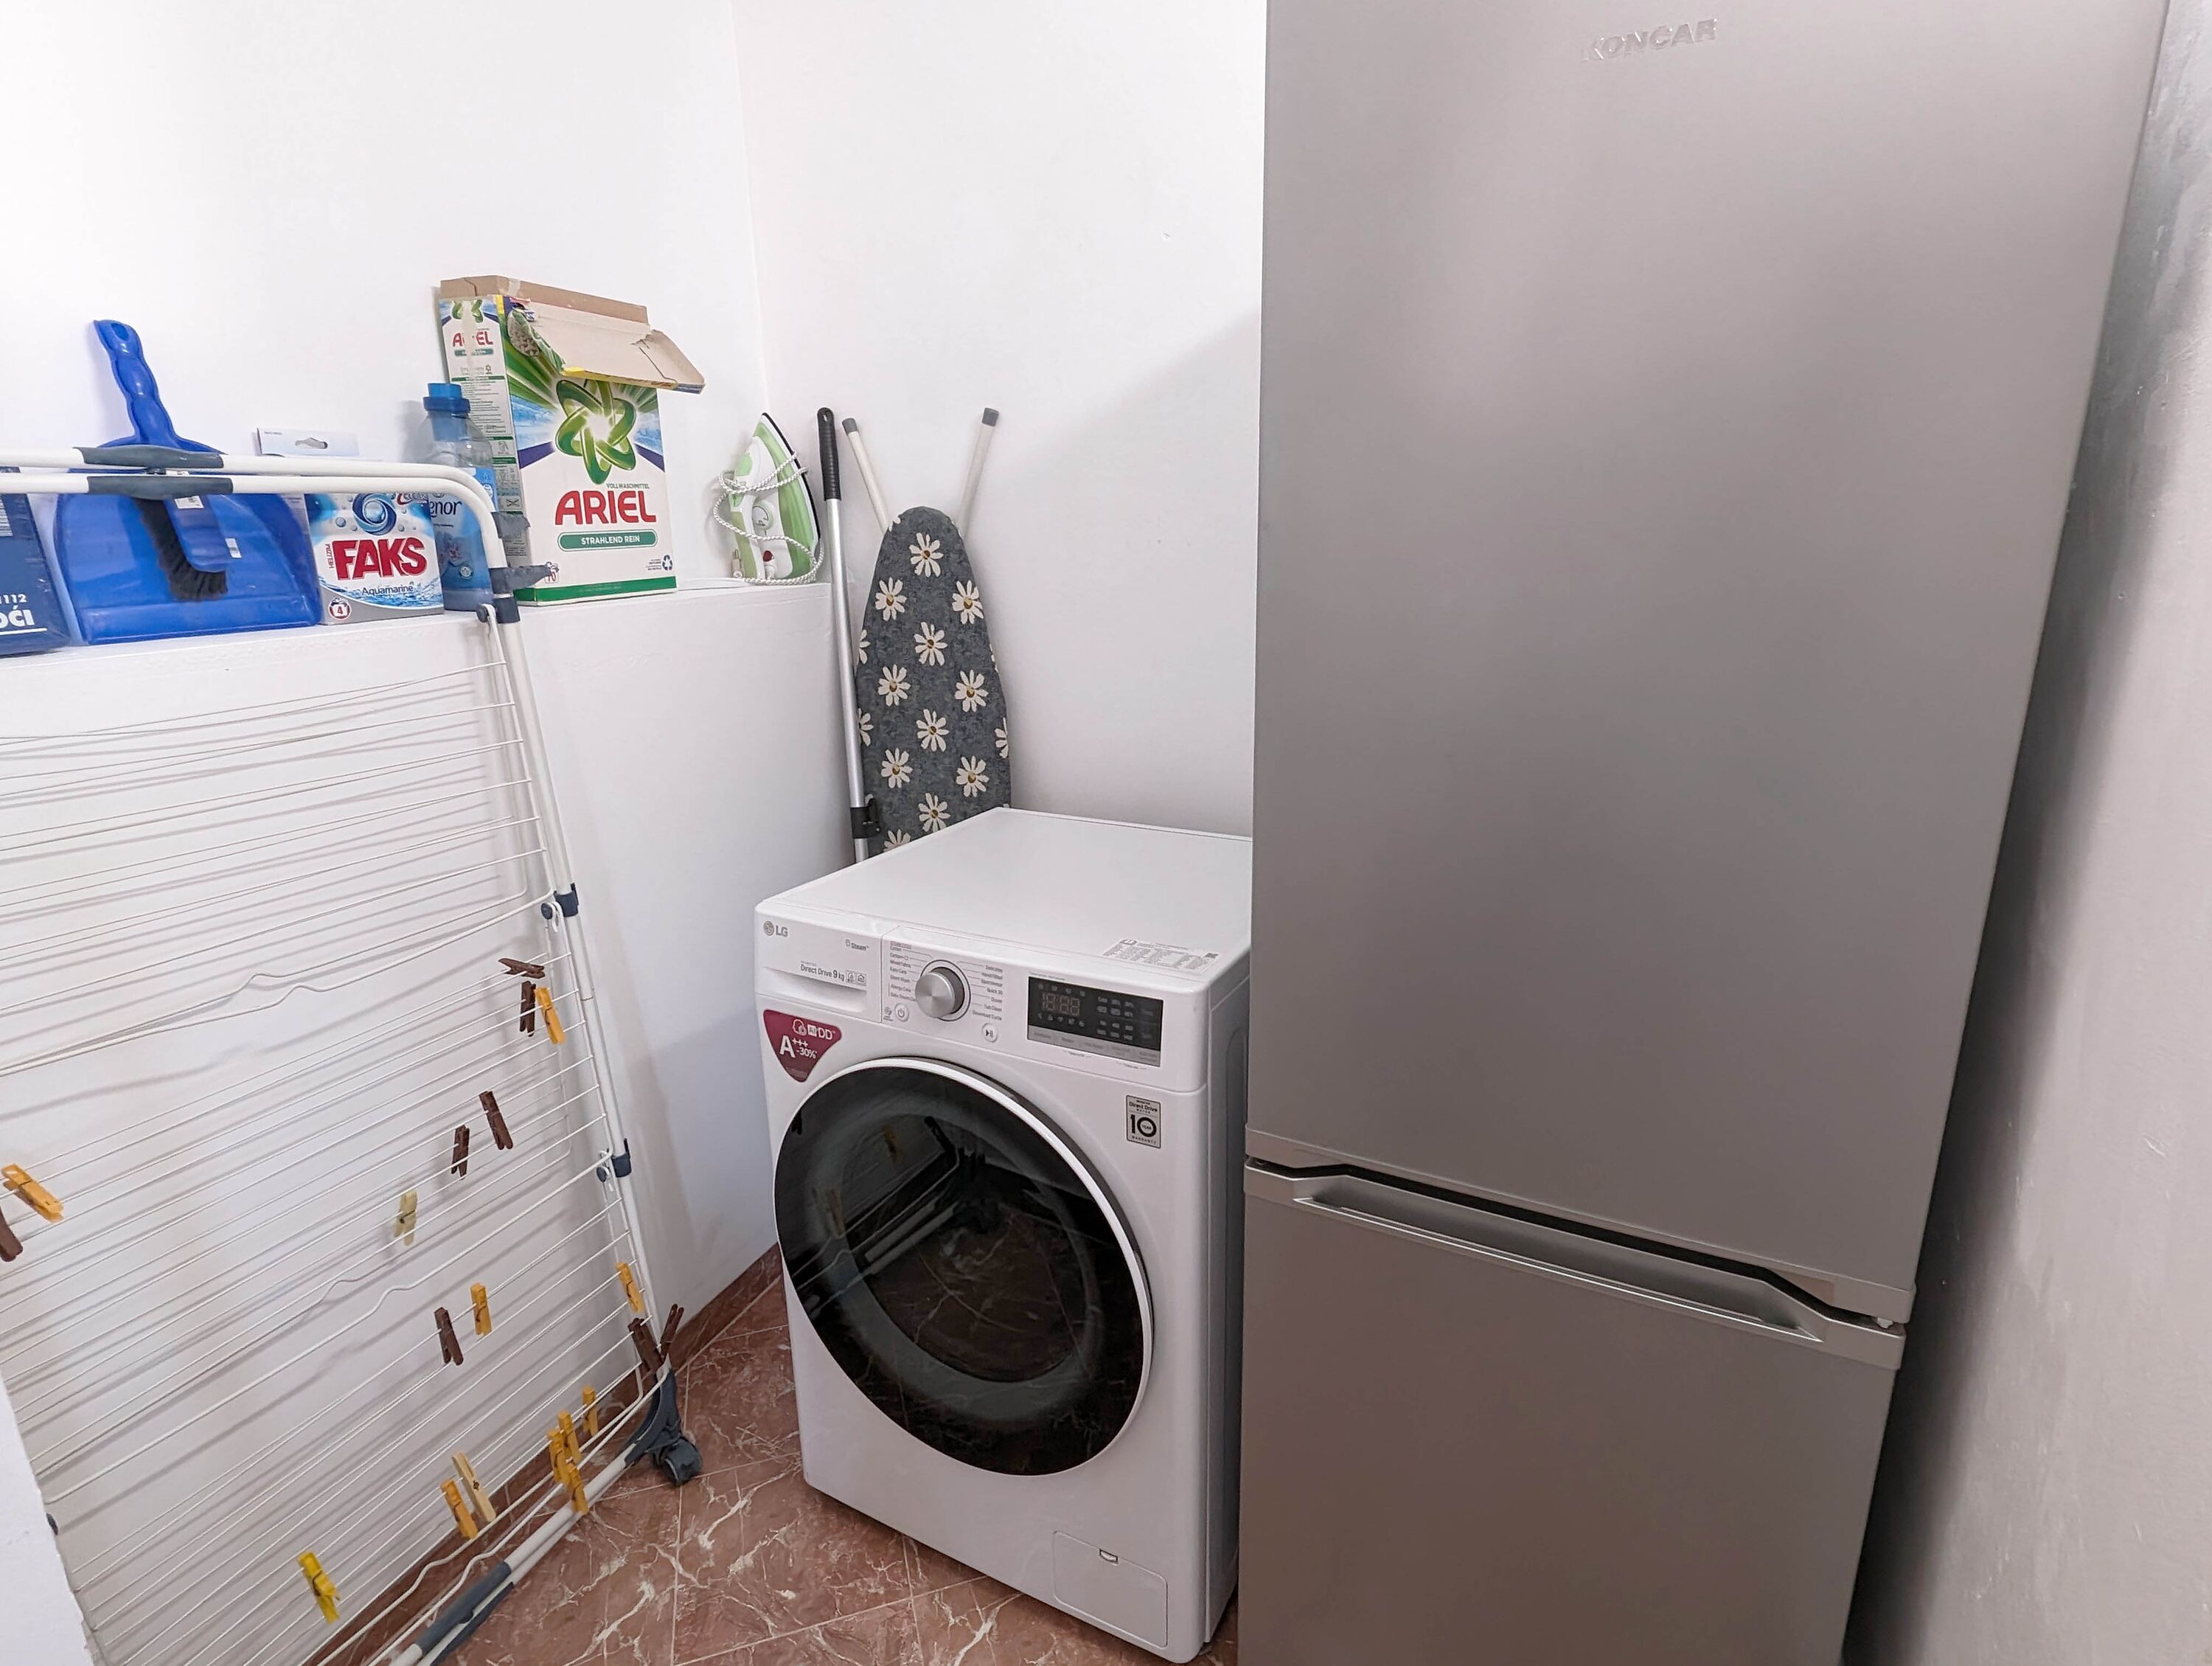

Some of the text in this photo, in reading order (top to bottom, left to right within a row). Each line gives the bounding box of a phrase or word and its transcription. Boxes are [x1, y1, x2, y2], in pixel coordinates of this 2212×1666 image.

[453, 331, 493, 347] AEL
[428, 501, 462, 517] enor
[555, 490, 656, 525] ARIEL
[581, 536, 623, 545] STRAHLEND
[332, 537, 427, 580] FAKS
[361, 584, 414, 596] Aquamarine
[0, 594, 27, 604] 112
[337, 606, 343, 615] 4
[776, 925, 788, 937] LG
[800, 964, 818, 974] Direct
[818, 968, 832, 978] Drive
[832, 970, 838, 979] 9
[818, 1027, 833, 1041] DD
[1130, 1114, 1157, 1138] 10
